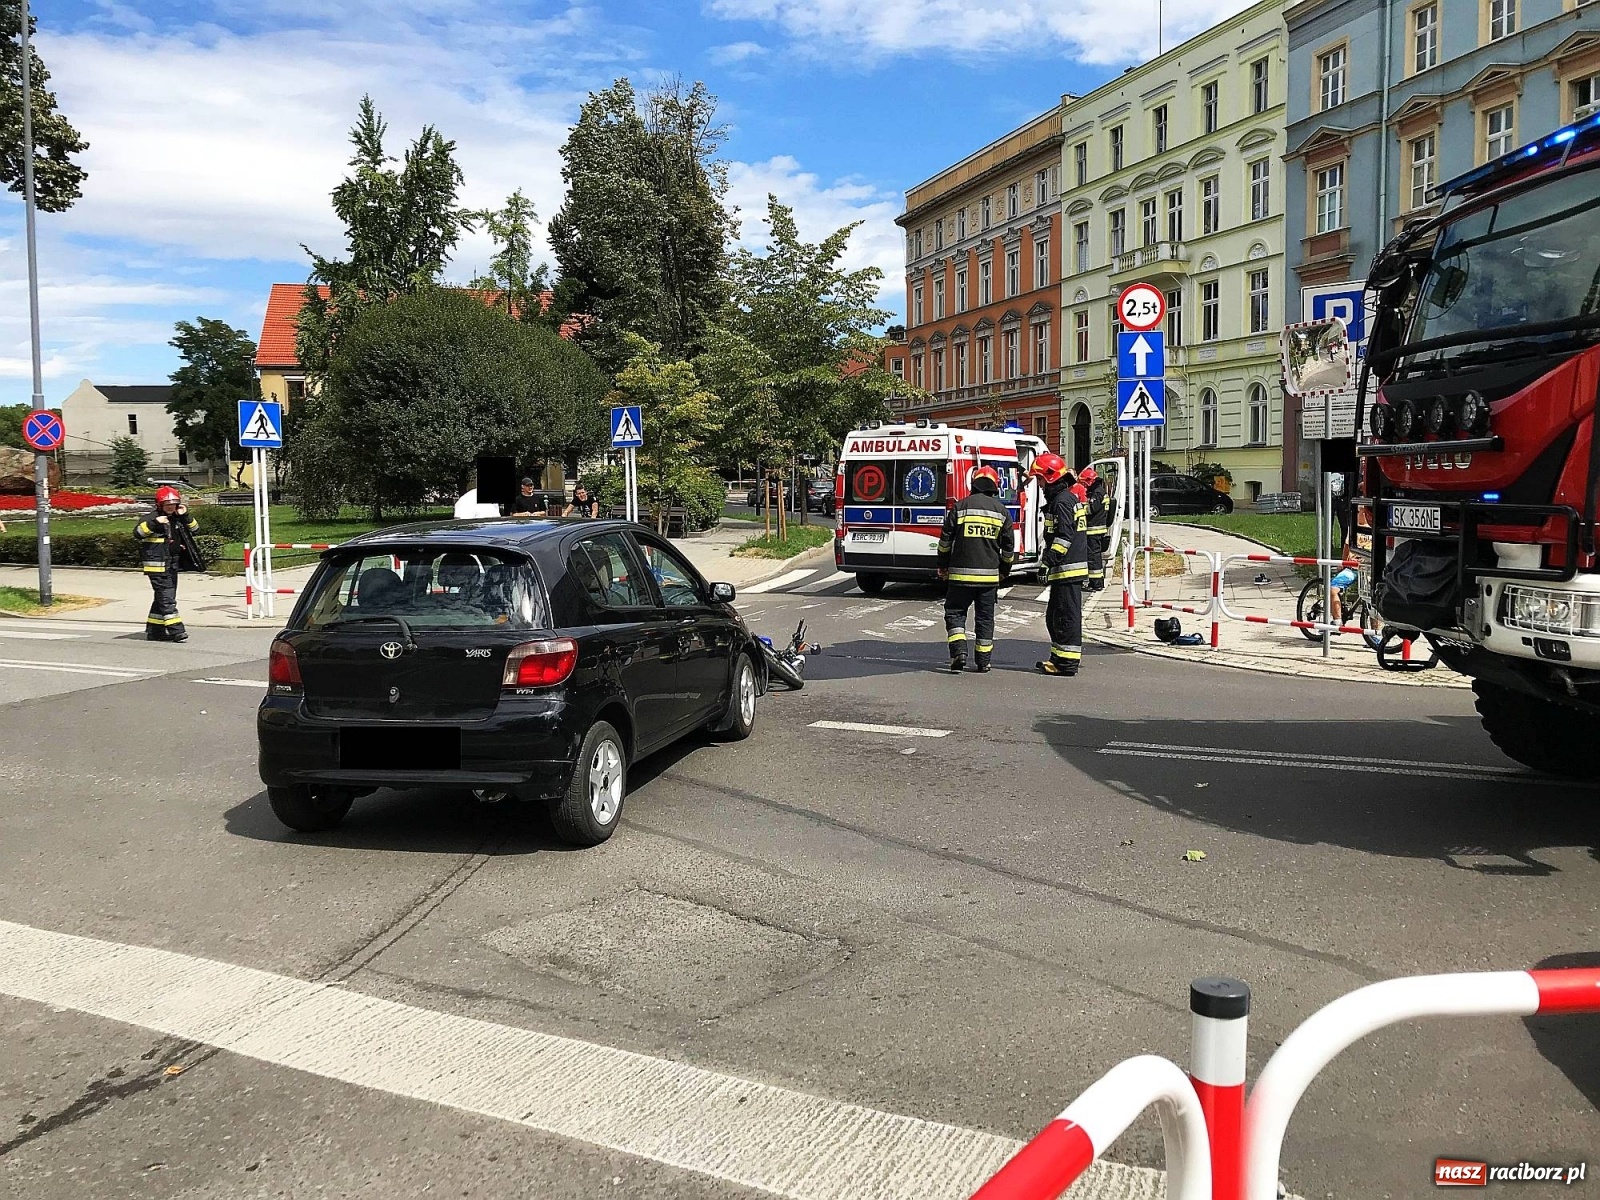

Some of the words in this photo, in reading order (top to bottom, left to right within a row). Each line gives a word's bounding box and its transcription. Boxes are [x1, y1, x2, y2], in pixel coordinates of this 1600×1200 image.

[1126, 299, 1157, 318] 2,5t
[849, 438, 942, 453] AMBULANS
[863, 472, 879, 493] P
[1394, 508, 1406, 526] SK
[1409, 508, 1439, 528] 356NE
[465, 648, 492, 658] YARIS
